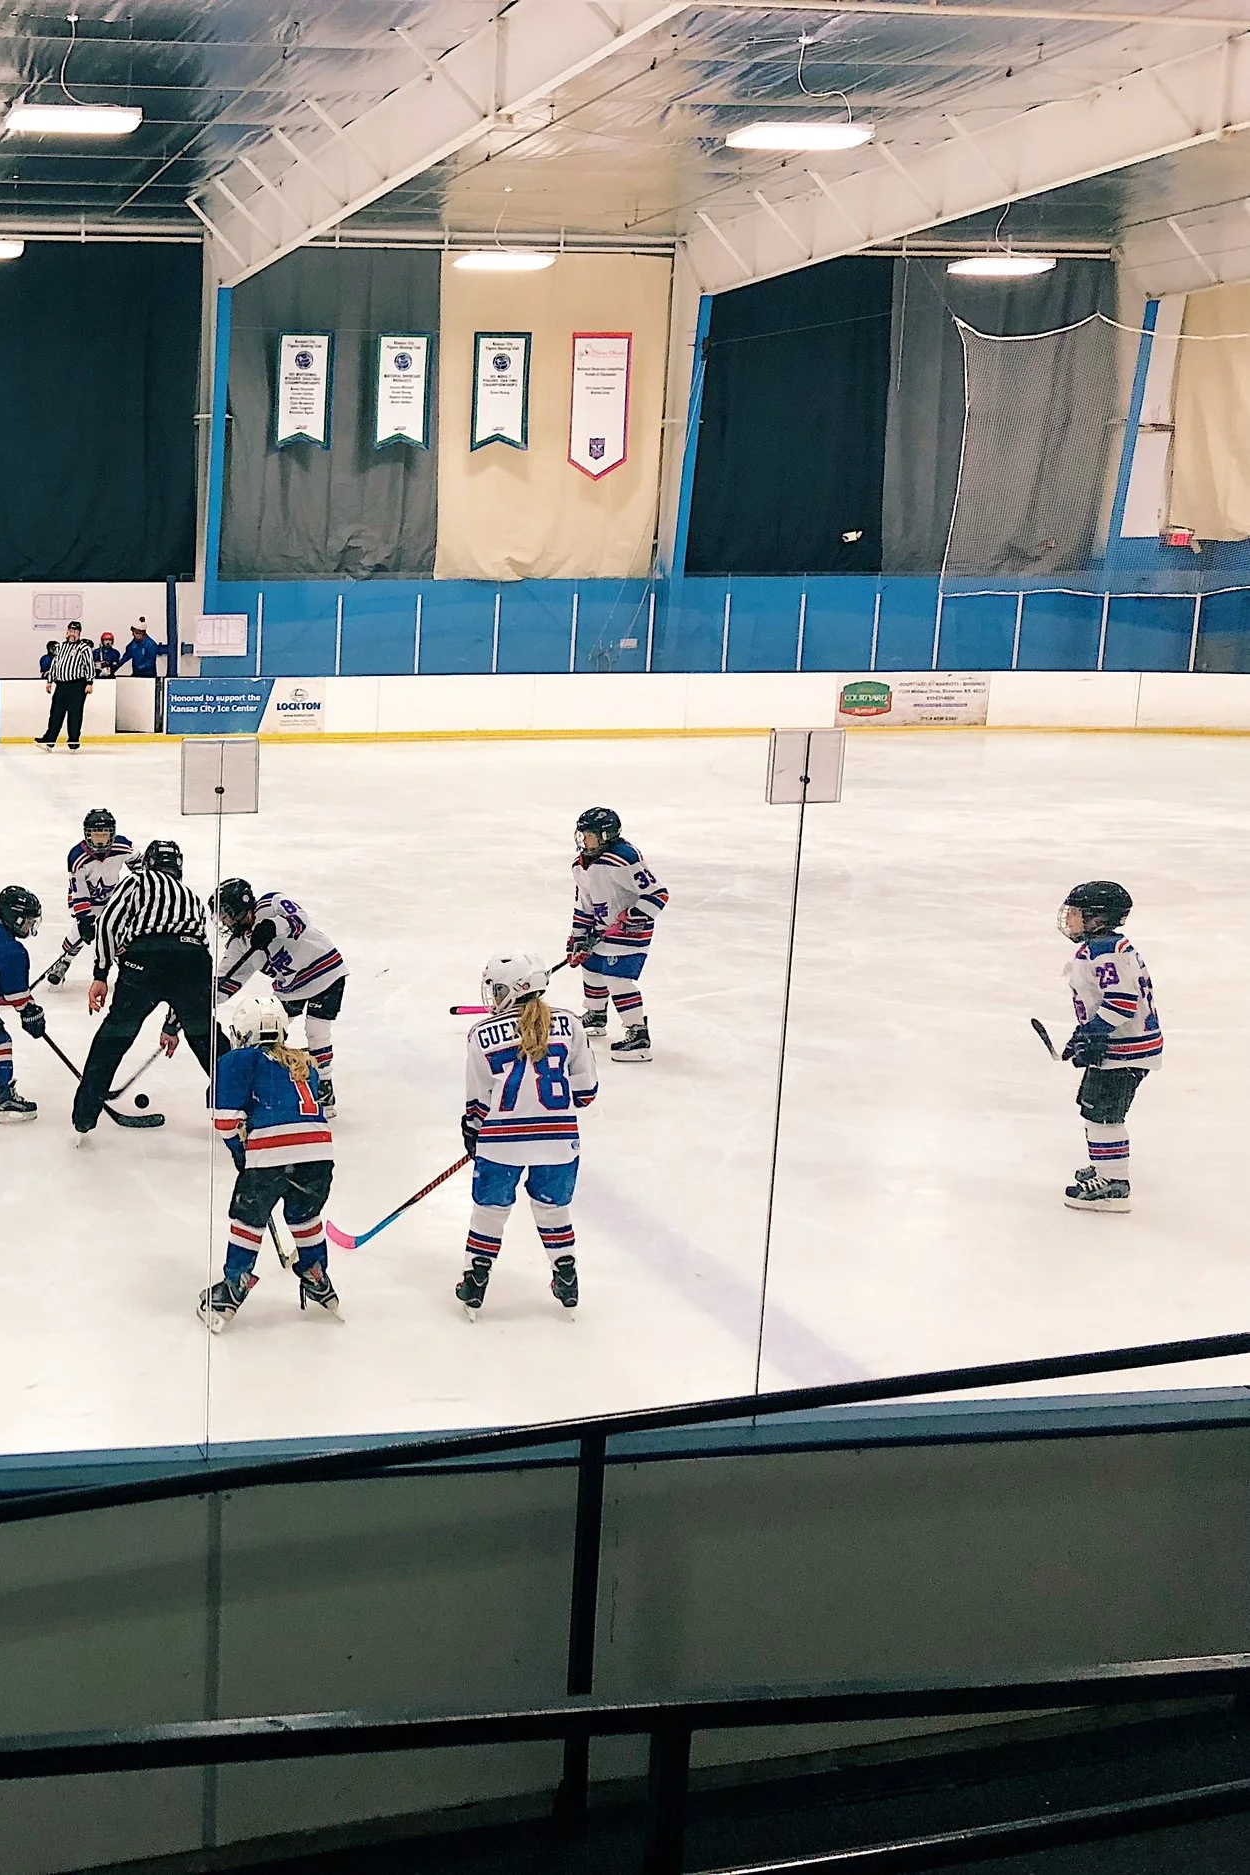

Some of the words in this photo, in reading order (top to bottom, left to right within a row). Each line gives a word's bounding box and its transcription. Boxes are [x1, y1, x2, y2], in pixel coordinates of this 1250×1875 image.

[171, 694, 203, 702] Honored
[206, 694, 214, 702] to
[216, 694, 246, 703] support
[844, 694, 888, 702] COURTYARD
[200, 705, 216, 713] City
[277, 702, 321, 710] LOCKTON
[478, 1016, 572, 1049] GUENER
[485, 1043, 571, 1112] 78
